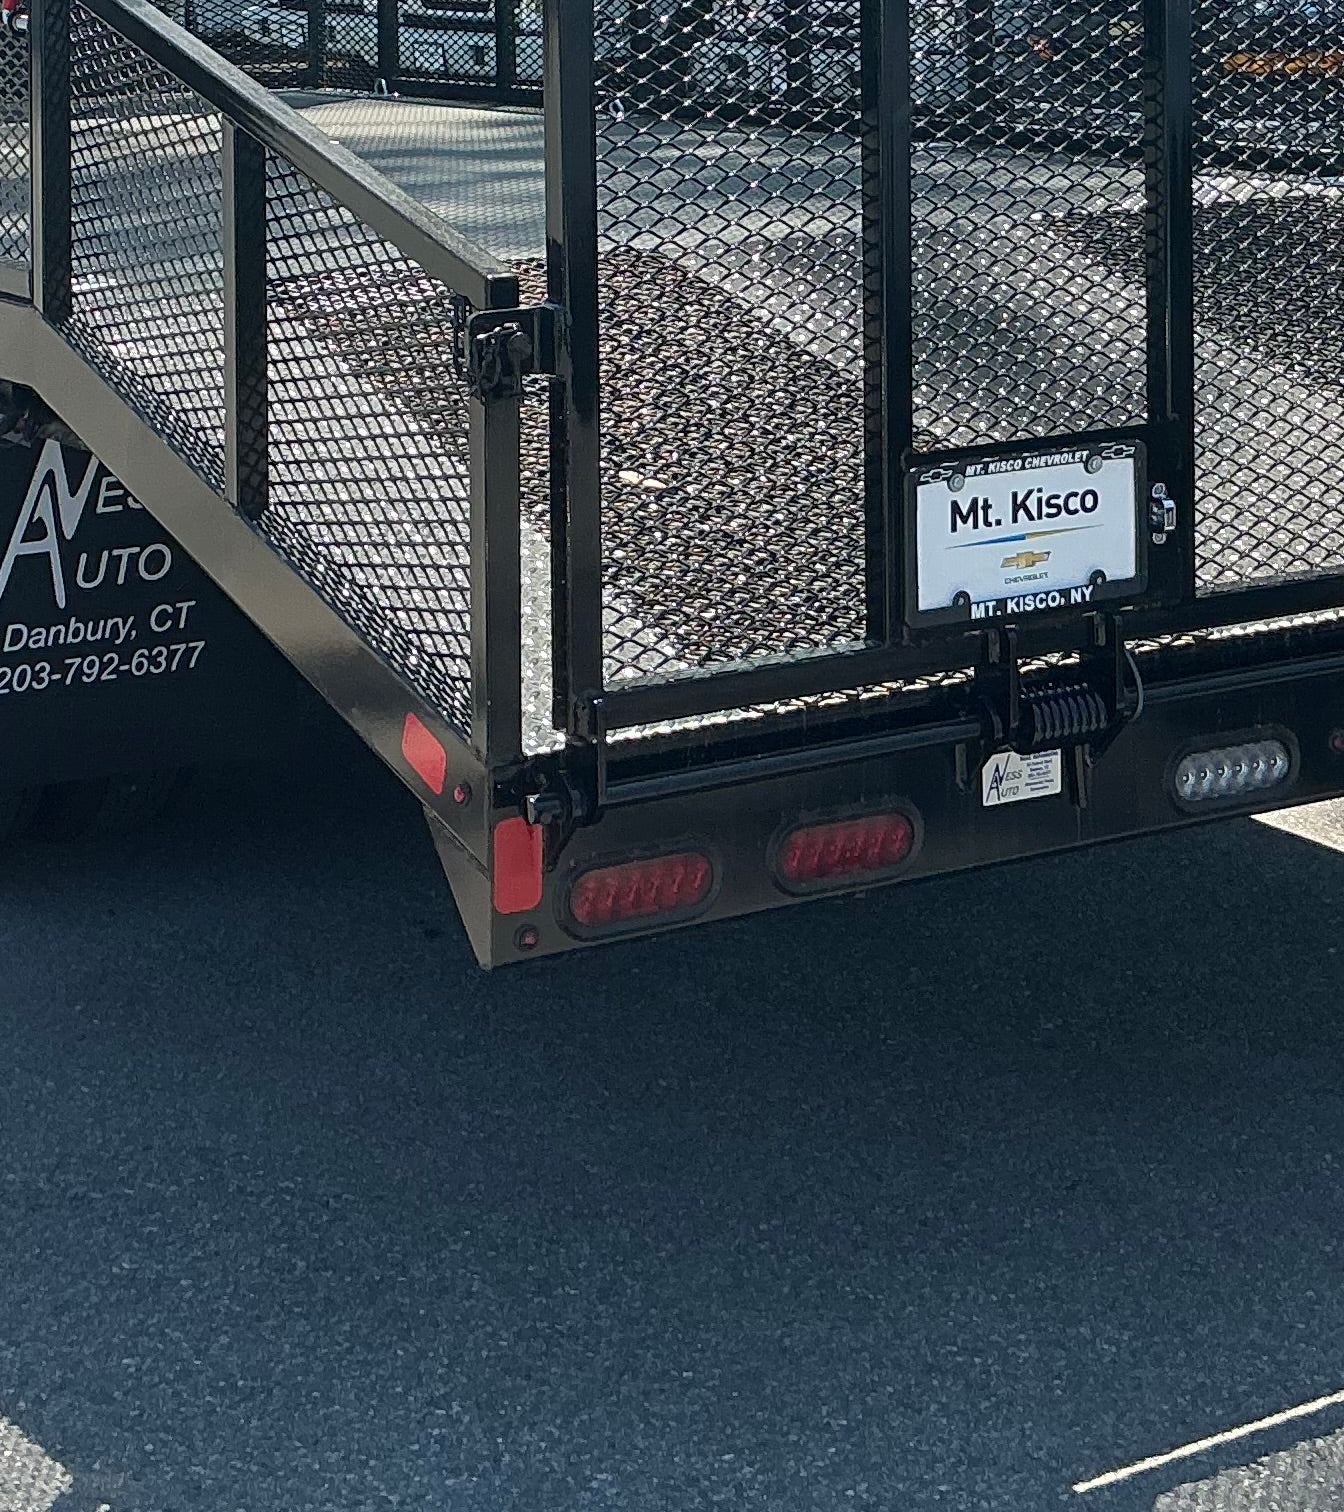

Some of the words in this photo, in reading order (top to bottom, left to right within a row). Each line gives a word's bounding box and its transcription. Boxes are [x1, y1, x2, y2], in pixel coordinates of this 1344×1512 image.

[965, 464, 985, 476] MT.
[987, 459, 1023, 474] KISCO
[1024, 450, 1090, 469] CHEVROLET
[950, 497, 1002, 533] Mt.
[1012, 487, 1099, 524] Kisco
[971, 601, 1002, 620] MT.
[1006, 591, 1065, 614] KISCO,
[1070, 585, 1094, 604] NY
[3, 616, 138, 653] Danbury,
[149, 600, 197, 633] CT
